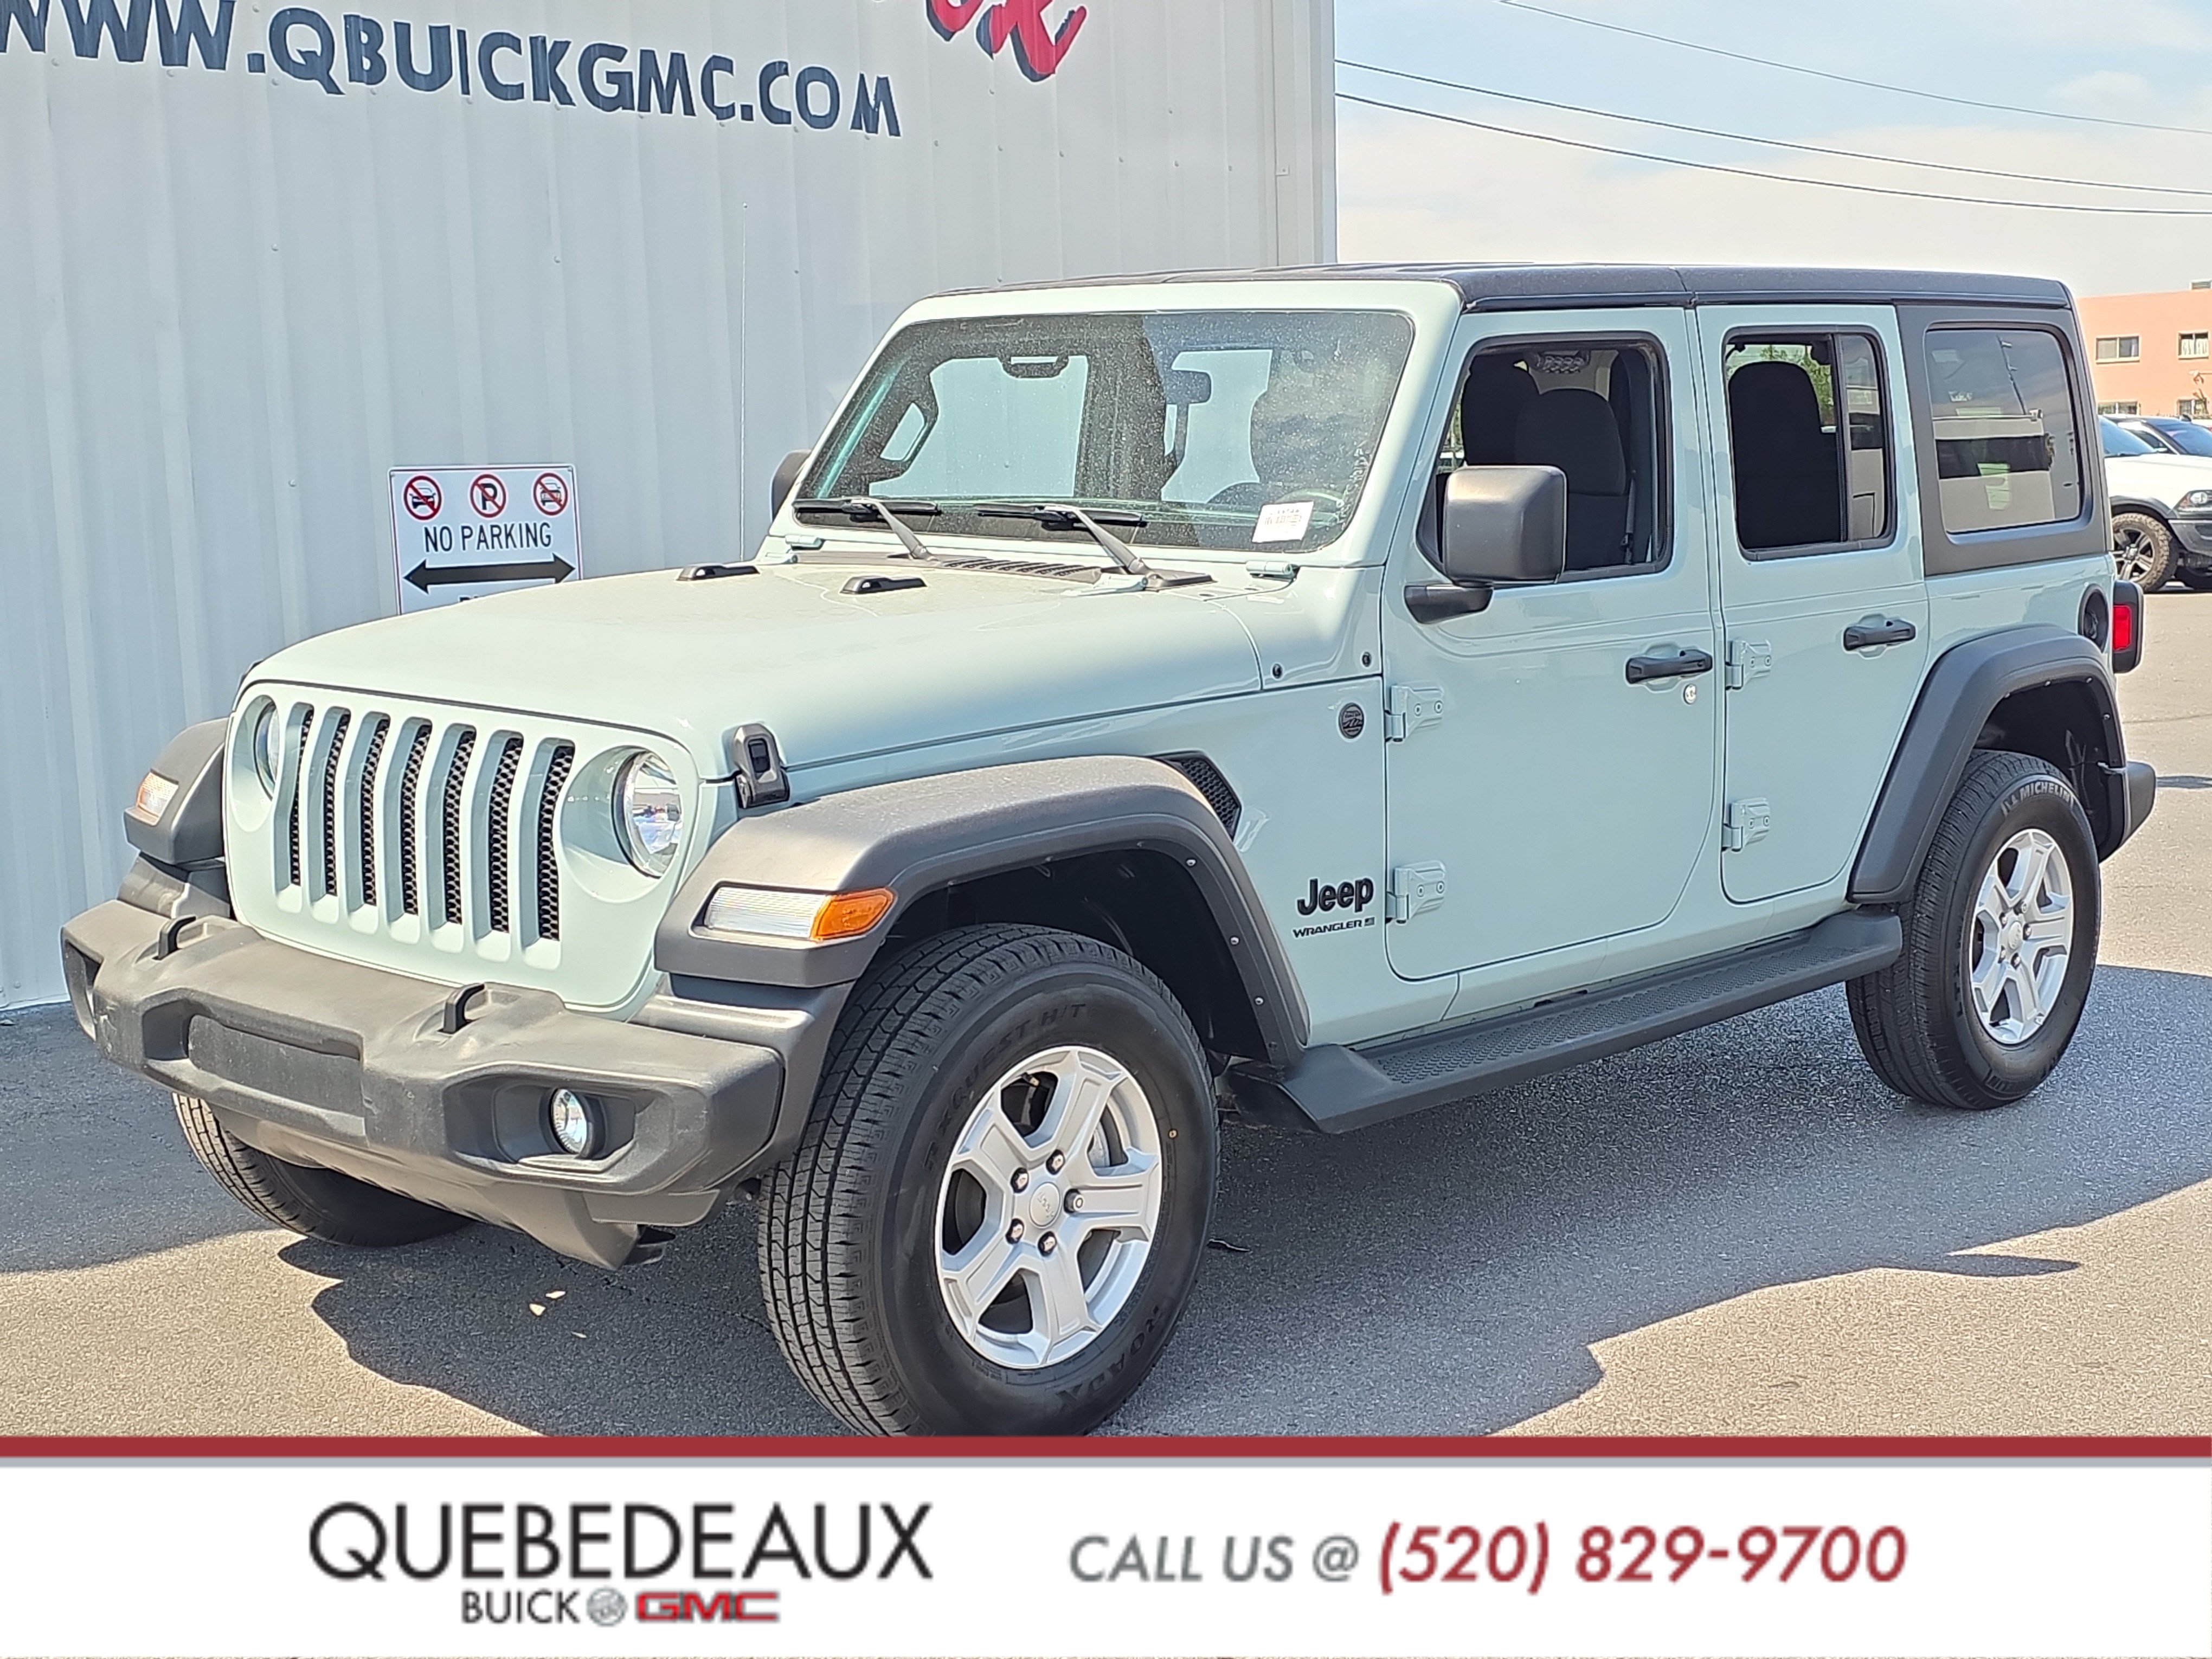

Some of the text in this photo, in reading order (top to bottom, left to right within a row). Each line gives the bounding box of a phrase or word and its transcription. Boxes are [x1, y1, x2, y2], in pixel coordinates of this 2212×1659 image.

[424, 522, 552, 552] NO PARKING
[2020, 781, 2074, 808] MICHELIN
[1297, 878, 1374, 915] Jeep
[1293, 919, 1362, 938] WRANGLER
